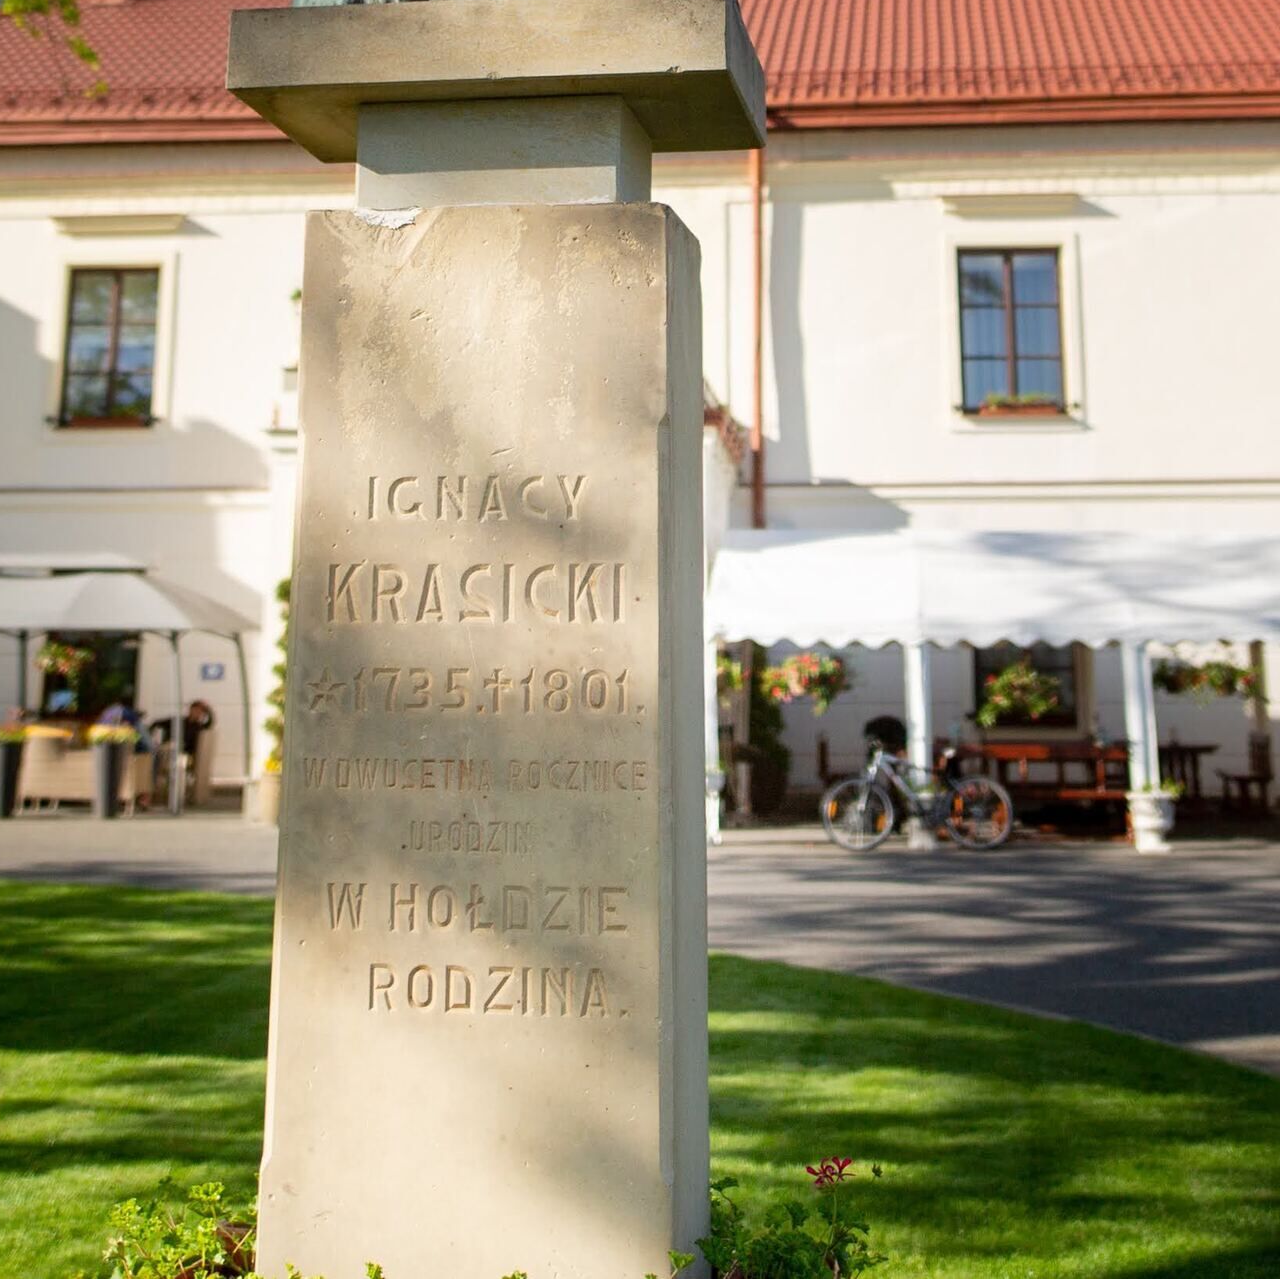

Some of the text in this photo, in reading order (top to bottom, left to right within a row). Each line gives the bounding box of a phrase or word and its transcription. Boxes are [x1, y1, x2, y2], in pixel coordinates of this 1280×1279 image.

[368, 474, 589, 522] IGNACY
[326, 559, 627, 624] KRASICKI
[303, 757, 327, 790] W
[327, 881, 630, 936] W HOŁDZIE
[368, 963, 632, 1018] RODZINA.
